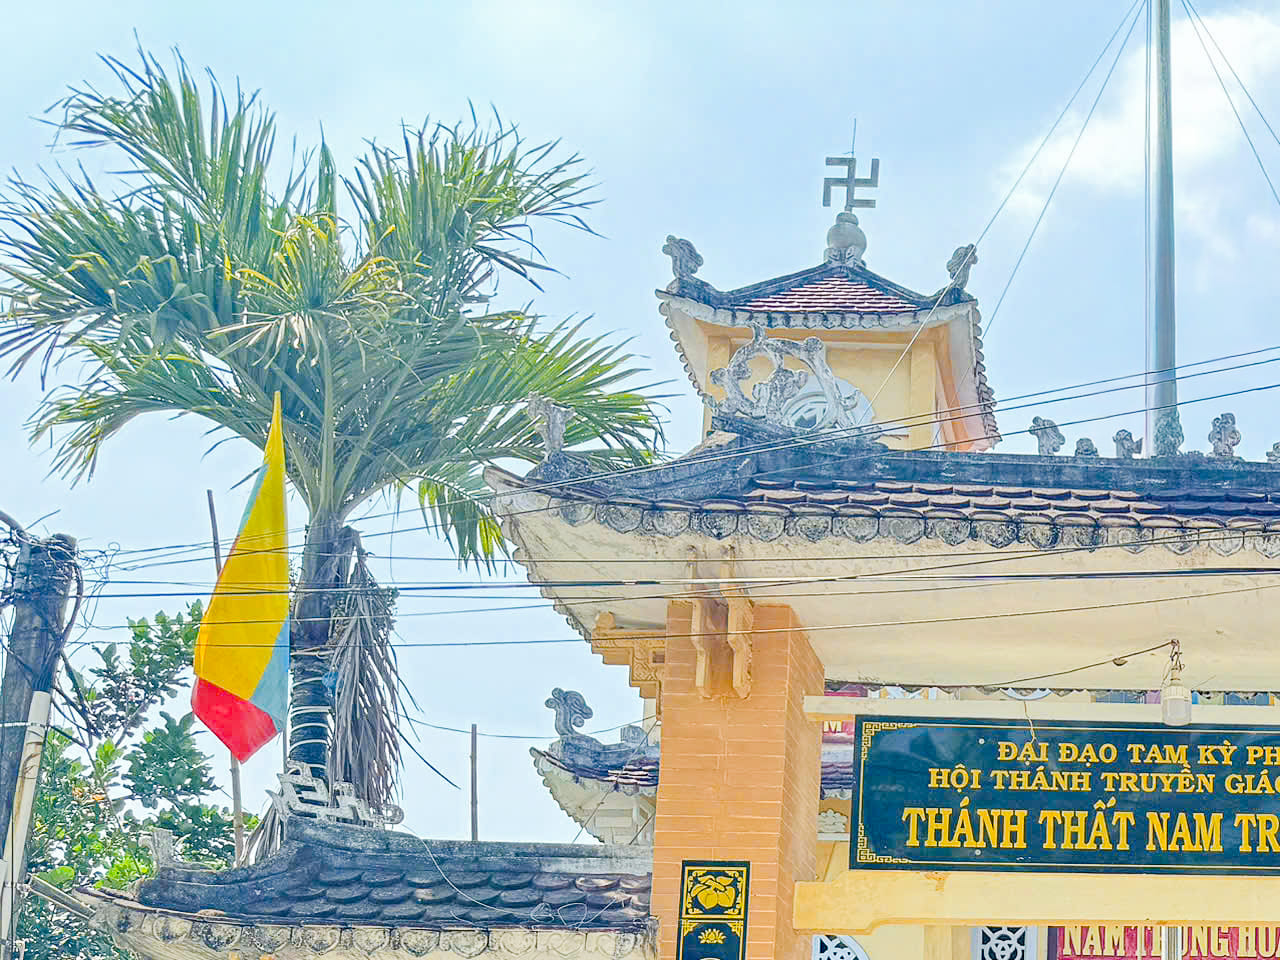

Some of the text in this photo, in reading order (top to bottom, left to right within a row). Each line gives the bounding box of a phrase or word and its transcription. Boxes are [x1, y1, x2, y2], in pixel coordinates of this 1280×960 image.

[997, 742, 1049, 765] ĐẠI
[1058, 742, 1118, 767] ĐẠO
[1127, 744, 1187, 766] TAM
[1198, 739, 1237, 766] KỲ
[928, 764, 982, 793] HỘI
[990, 766, 1092, 792] THÁNH
[1101, 762, 1215, 793] TRUYỀN
[902, 796, 1028, 849] THÁNH
[1038, 795, 1136, 850] THẤT
[1146, 811, 1224, 852] NAM
[1063, 926, 1126, 957] NAM
